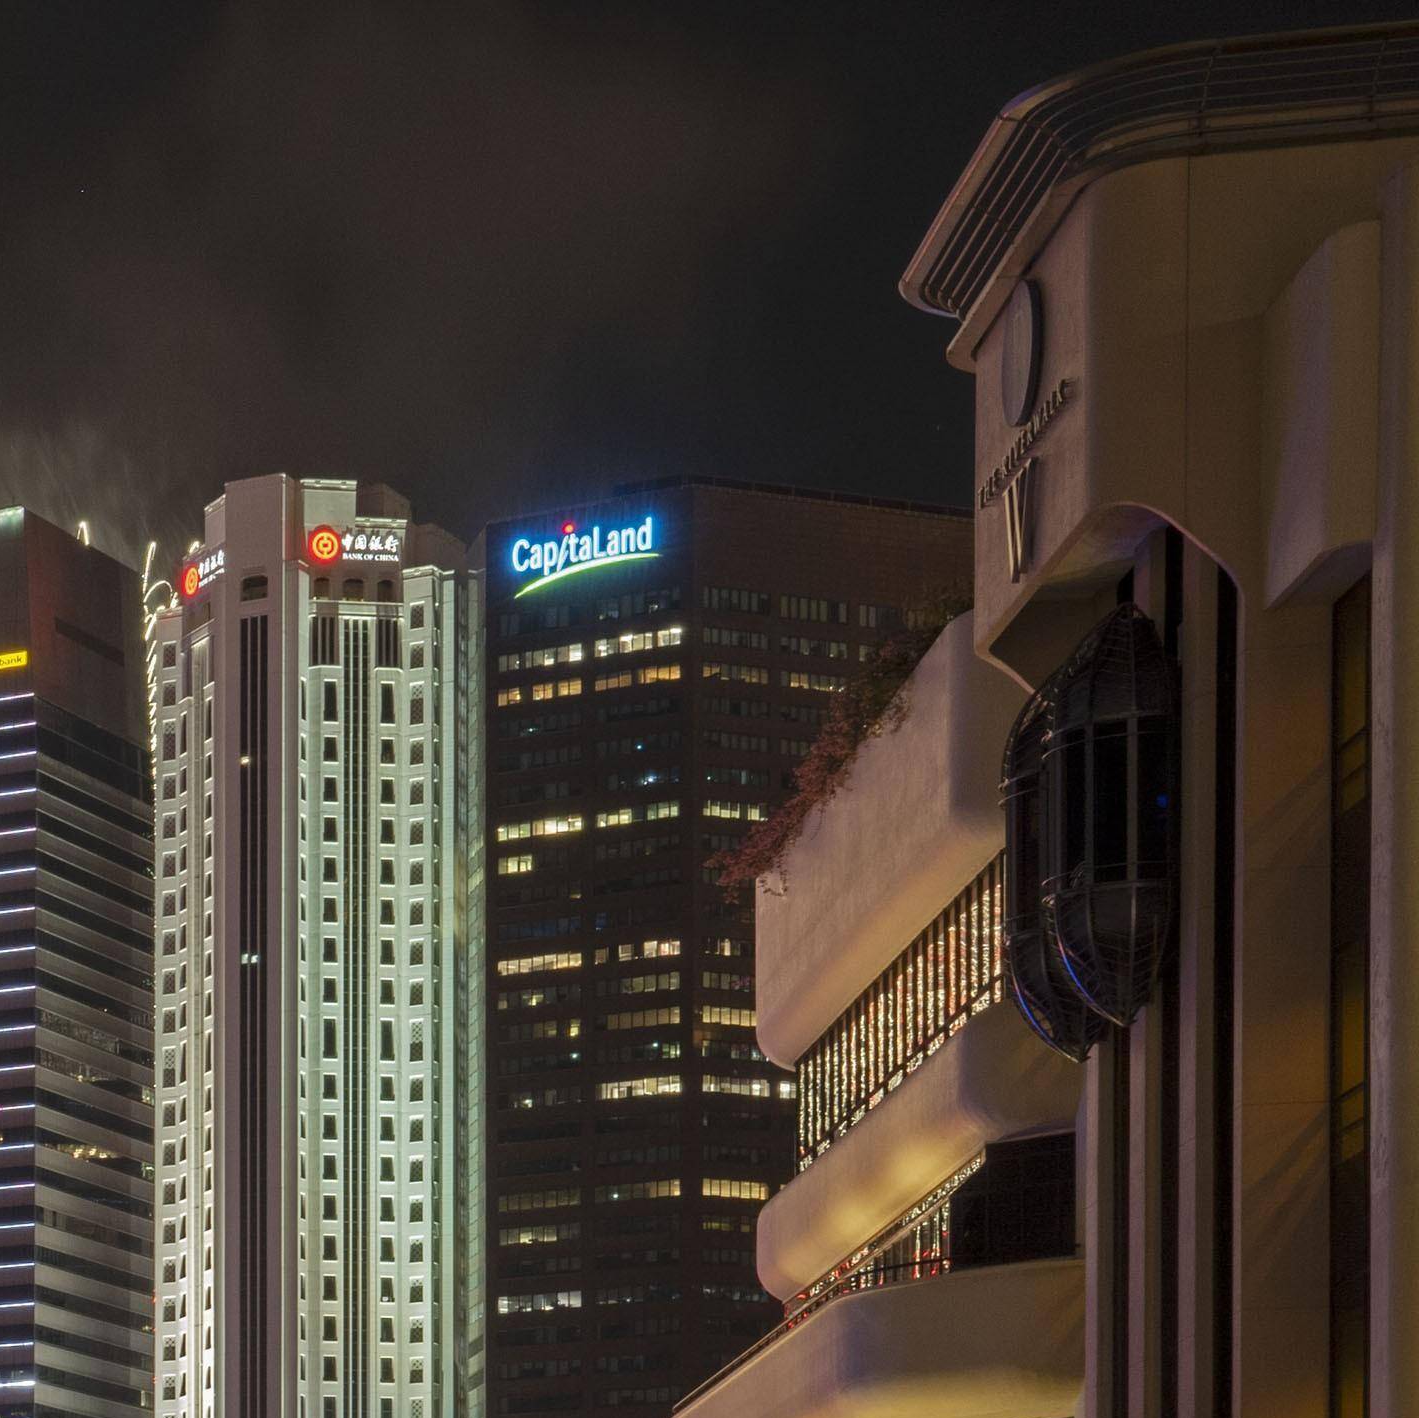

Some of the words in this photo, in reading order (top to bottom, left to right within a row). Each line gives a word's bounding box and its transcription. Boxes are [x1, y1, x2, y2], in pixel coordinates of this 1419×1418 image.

[343, 552, 363, 561] BANK
[374, 554, 399, 562] CHINA
[512, 516, 652, 576] CapitaLand
